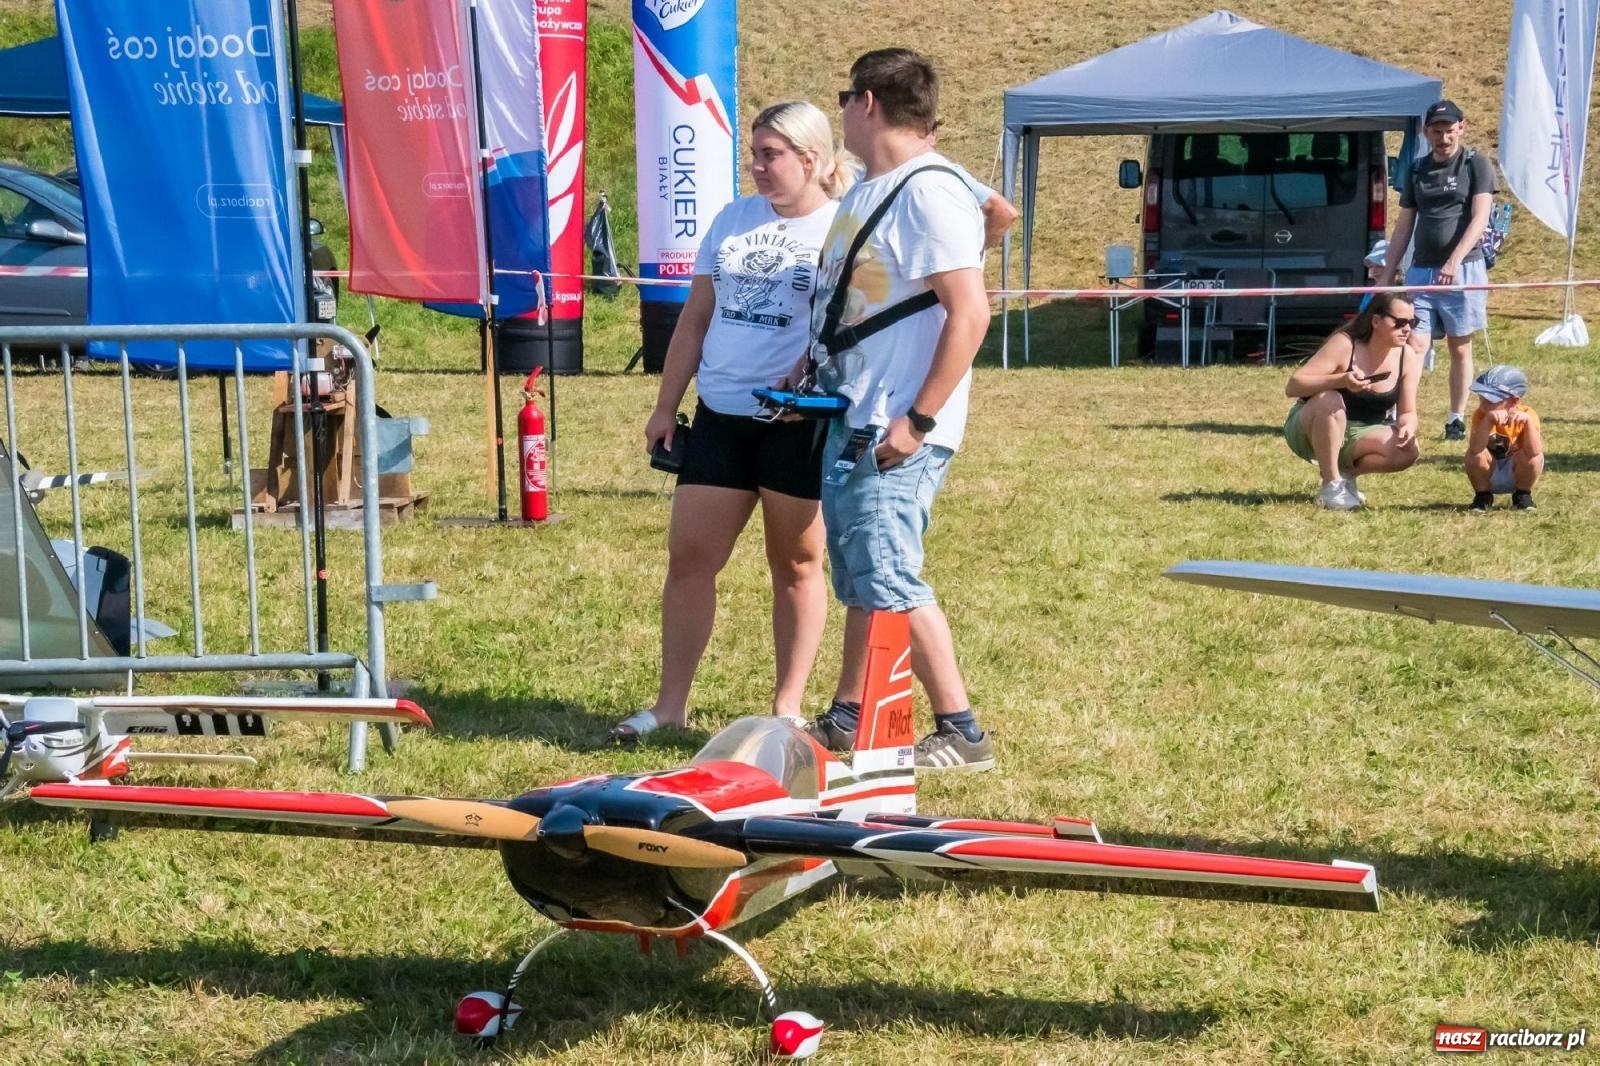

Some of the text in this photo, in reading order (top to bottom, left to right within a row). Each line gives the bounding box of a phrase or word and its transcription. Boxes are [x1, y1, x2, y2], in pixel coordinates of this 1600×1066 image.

[536, 6, 562, 17] upa
[658, 156, 669, 201] BIAŁY
[672, 124, 697, 239] CUKIER
[745, 233, 804, 253] VINTAGE
[659, 263, 695, 275] POLSK
[888, 706, 912, 739] Pilot
[638, 842, 669, 853] FOXY
